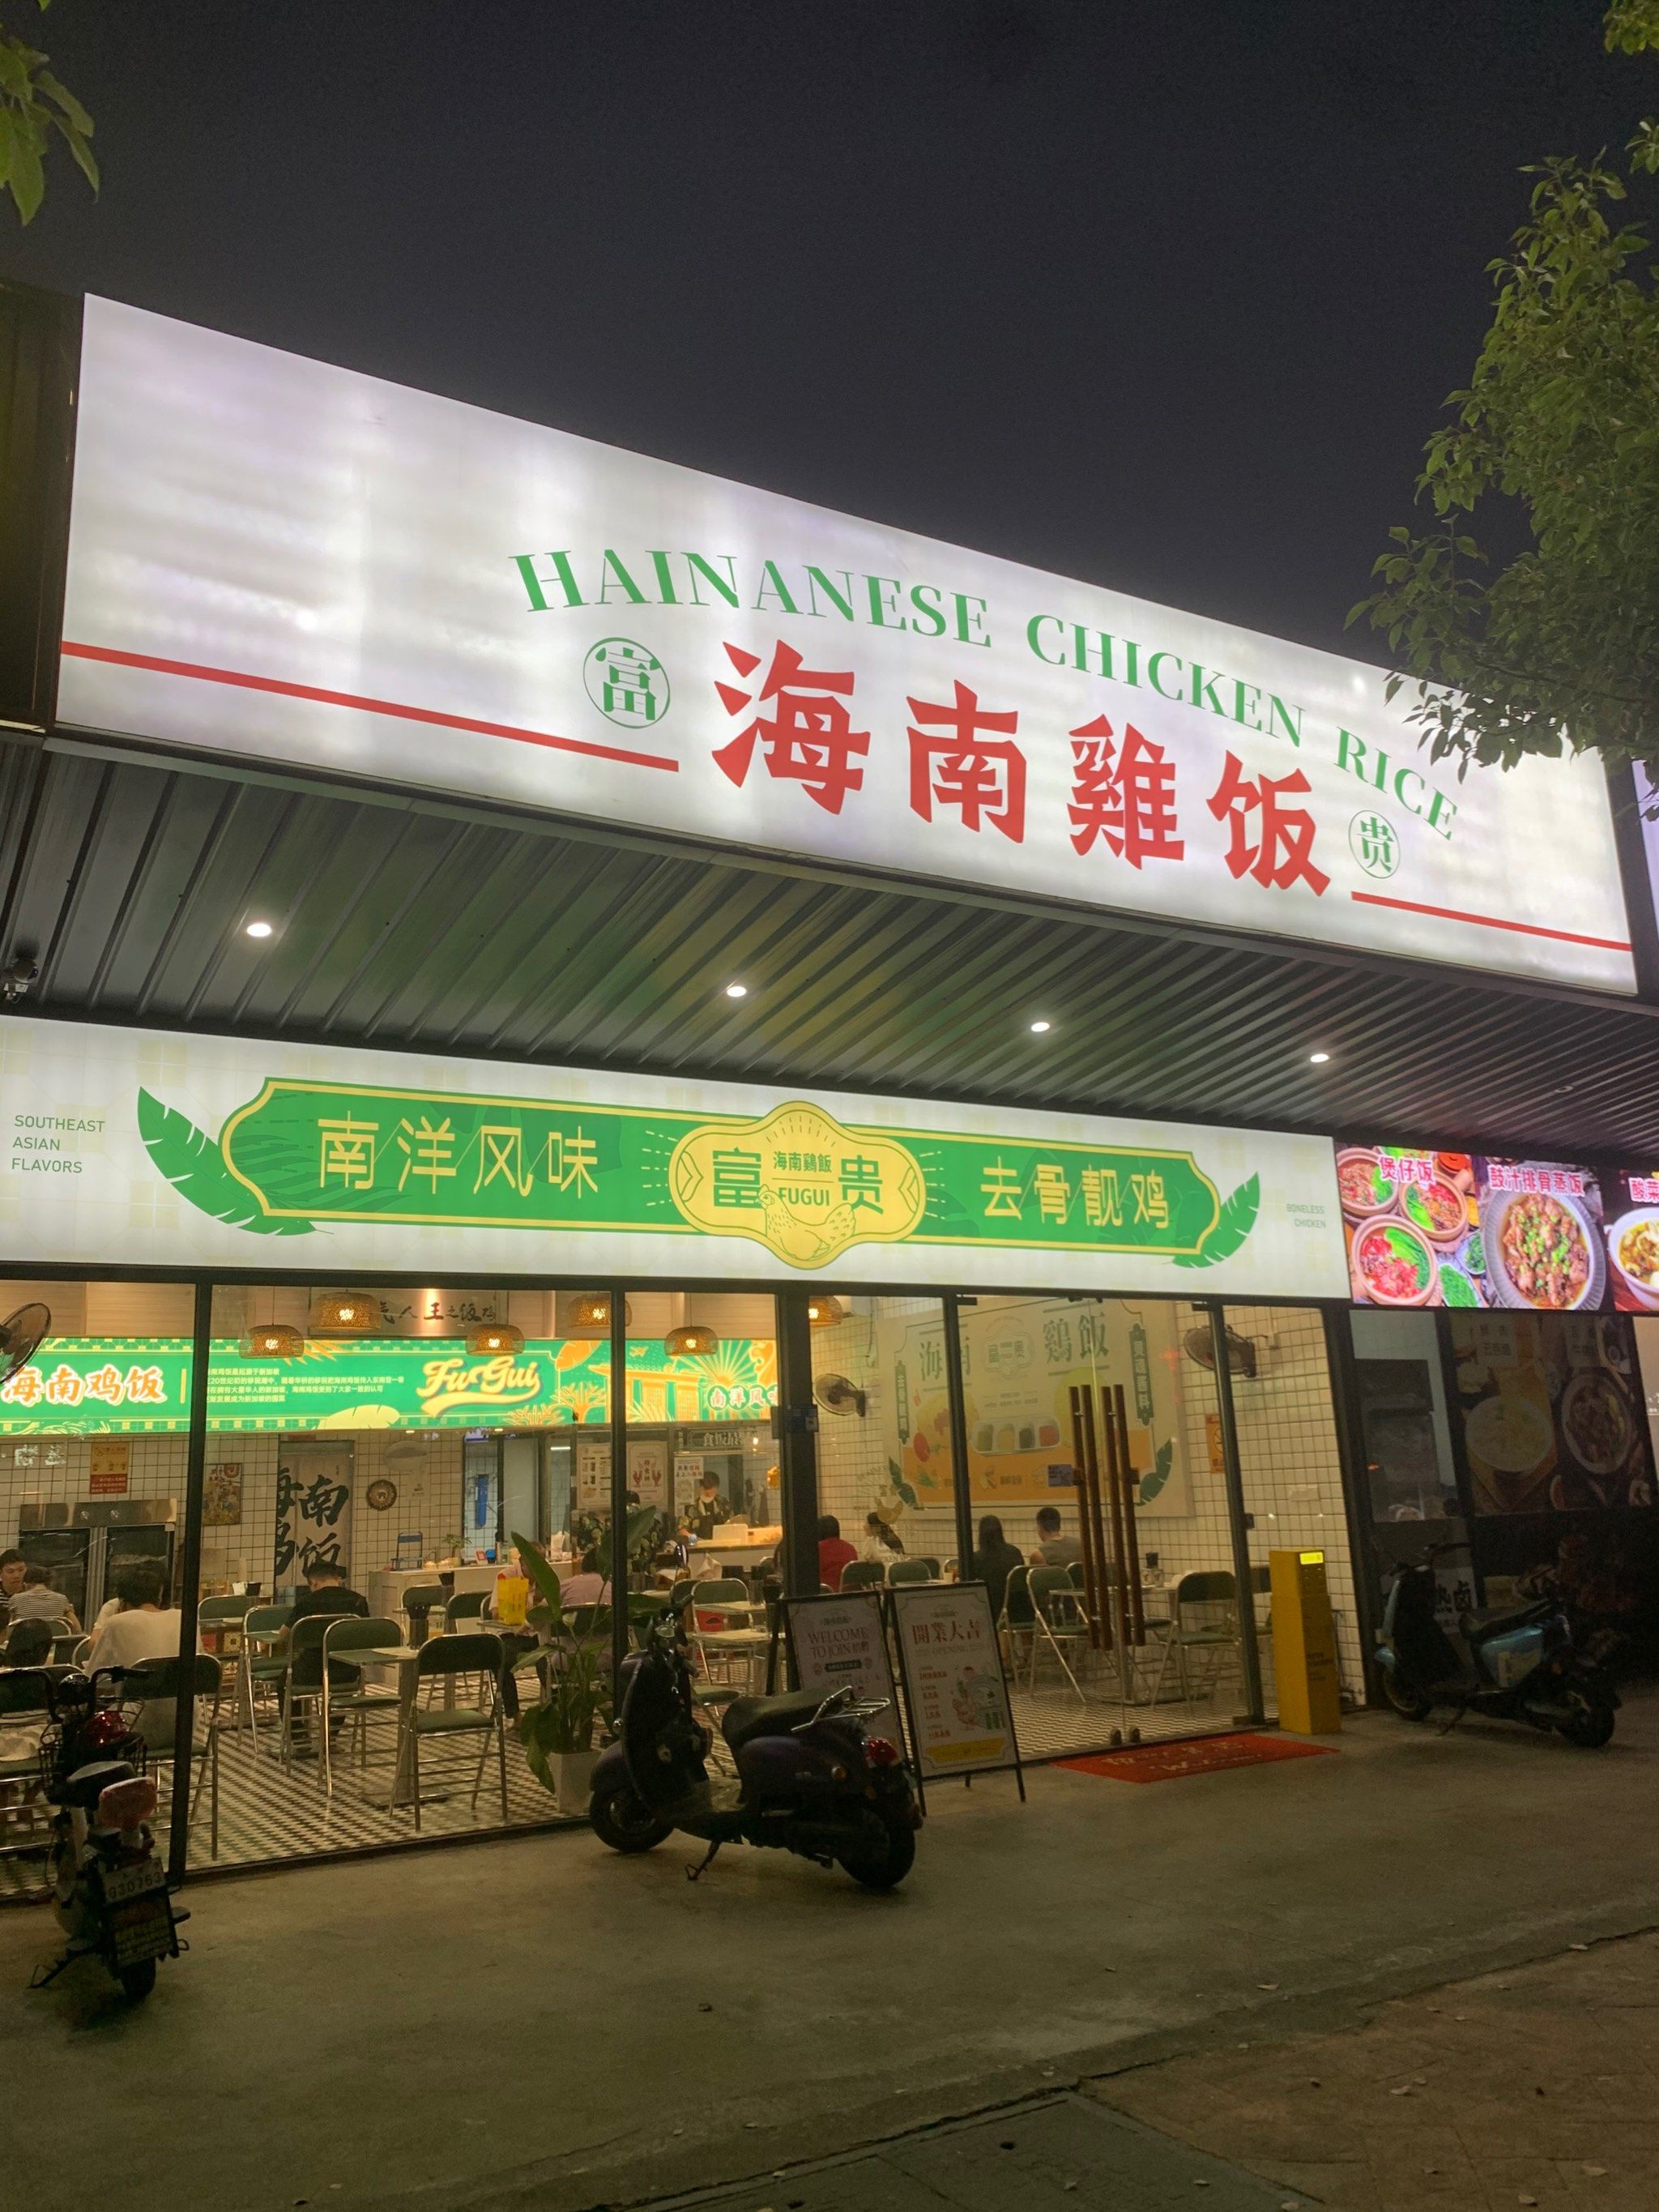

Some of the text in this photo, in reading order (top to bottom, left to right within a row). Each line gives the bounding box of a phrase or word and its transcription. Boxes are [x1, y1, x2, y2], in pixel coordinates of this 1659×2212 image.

[508, 549, 1458, 840] HAINANESE CHICKEN RICE
[595, 647, 661, 720] 富
[1356, 816, 1395, 873] 贵
[14, 1114, 105, 1133] SOUTHEAST
[13, 1136, 61, 1151] ASIAN
[318, 1110, 598, 1199] 南洋风味
[11, 1157, 83, 1174] FLAVORS
[1380, 1155, 1435, 1184] 煲仔饭
[712, 1147, 884, 1215] 富 贵
[981, 1156, 1169, 1229] 去骨靓鸡
[777, 1186, 831, 1207] FUGUI
[1286, 1202, 1325, 1215] BONELESS
[1294, 1218, 1326, 1228] CHICKEN
[2, 1365, 165, 1405] 海南鸡饭
[808, 1627, 869, 1644] WELCOME
[912, 1619, 980, 1645] 開業大吉
[810, 1646, 826, 1659] TO
[828, 1642, 851, 1659] JOIN
